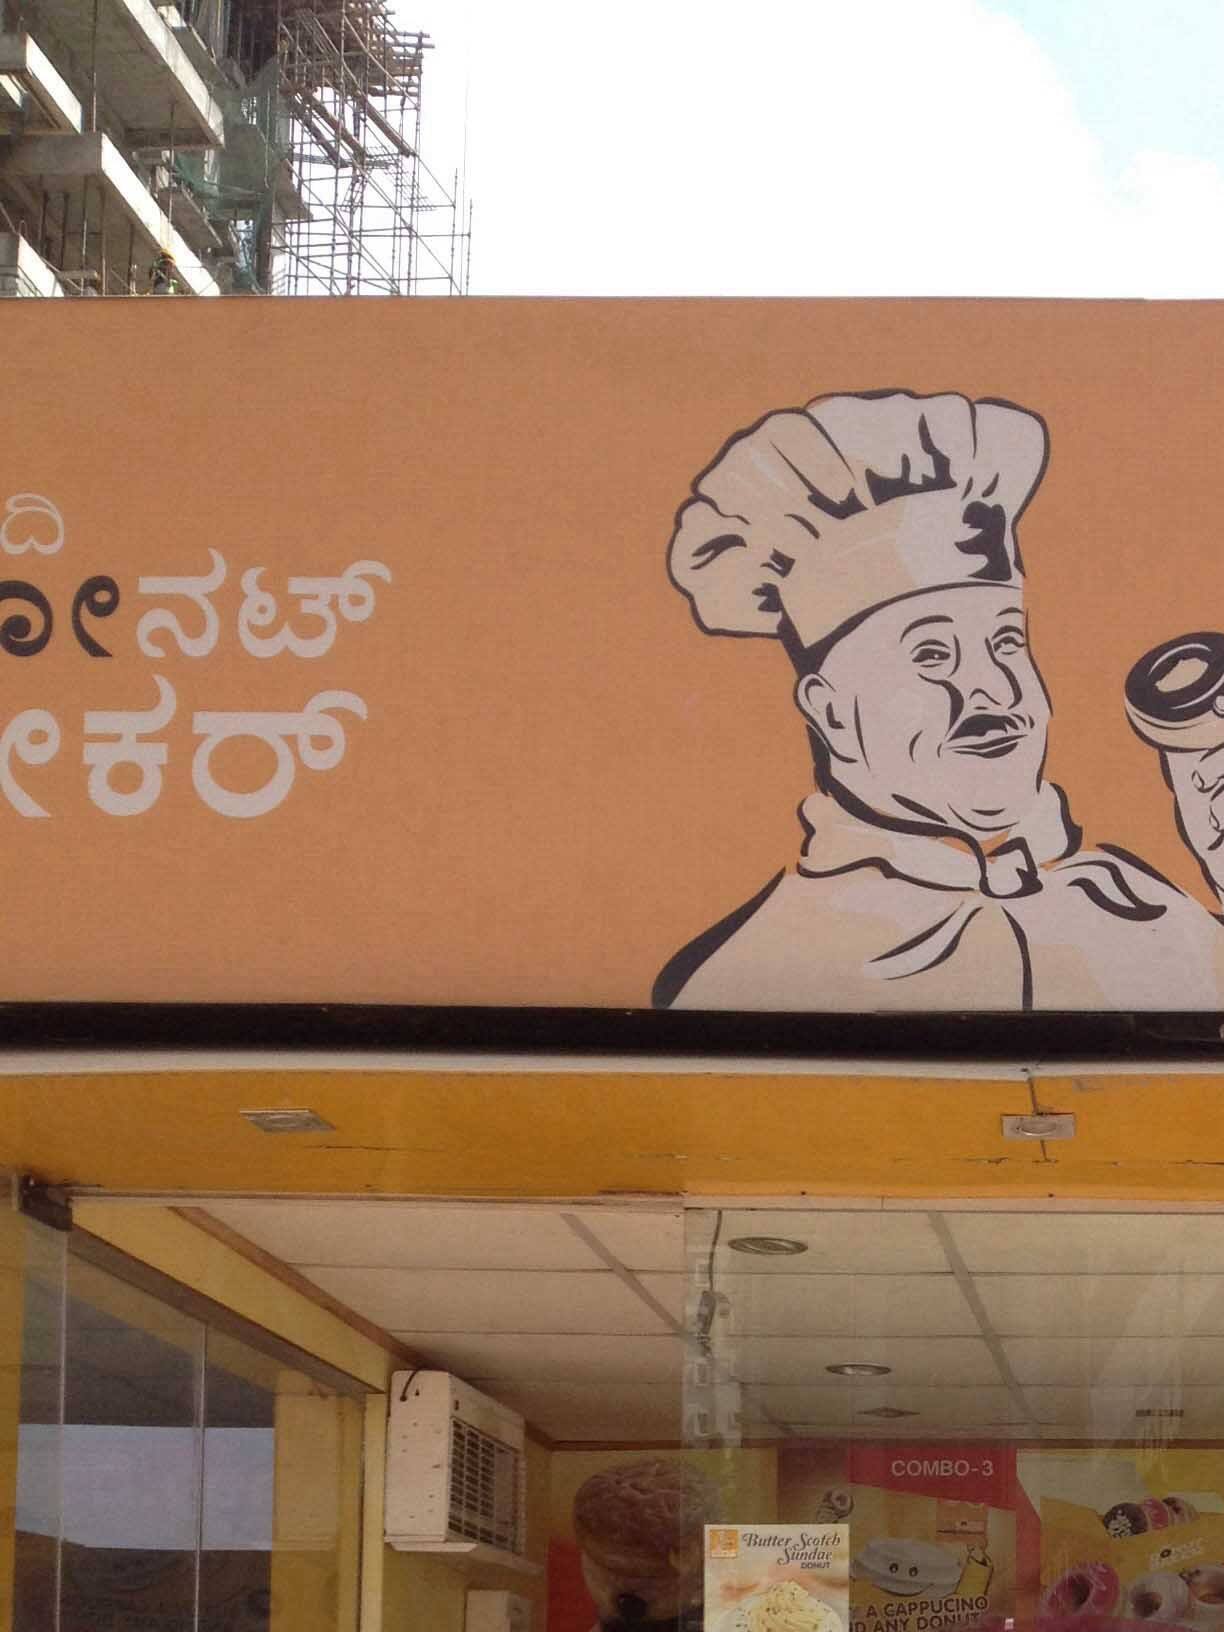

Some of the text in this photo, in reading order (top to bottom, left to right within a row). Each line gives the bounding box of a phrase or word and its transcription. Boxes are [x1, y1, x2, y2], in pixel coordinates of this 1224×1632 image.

[891, 1459, 994, 1477] COMBO-3
[742, 1532, 793, 1548] Butter
[866, 1597, 988, 1619] A CAPPUCINO
